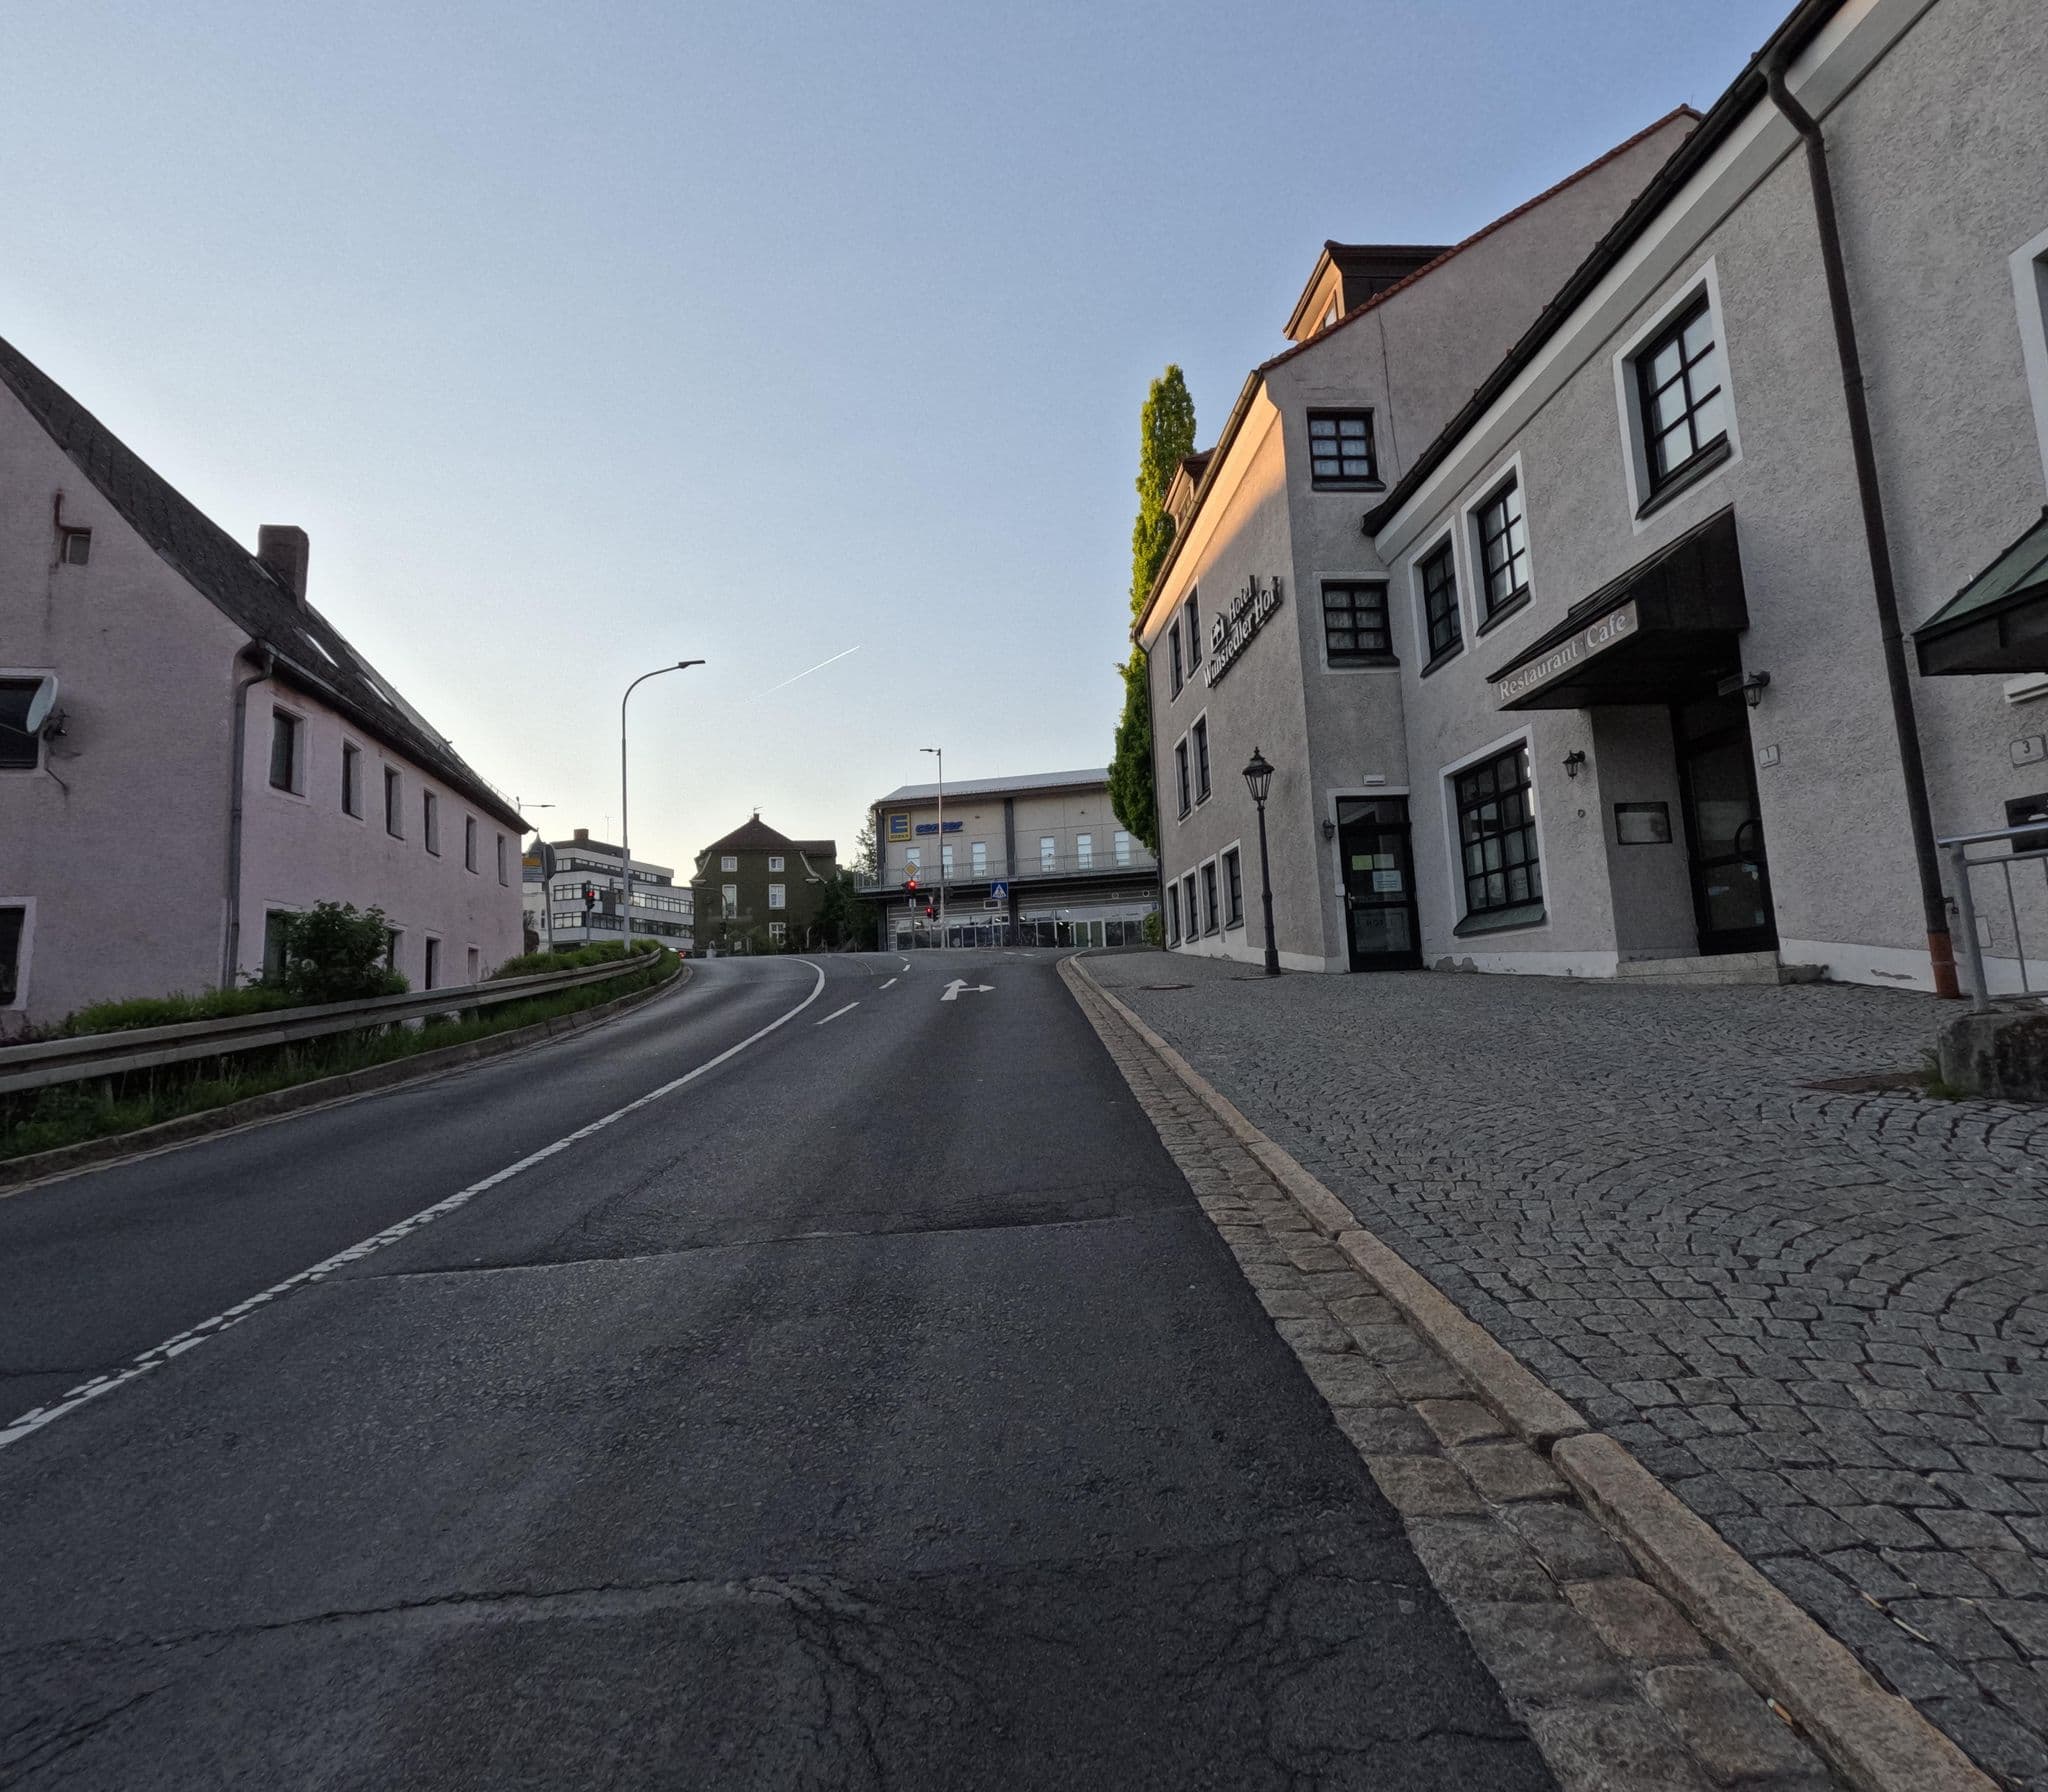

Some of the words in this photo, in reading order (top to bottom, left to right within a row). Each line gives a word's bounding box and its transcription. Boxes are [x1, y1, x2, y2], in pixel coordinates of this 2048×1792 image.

[1203, 612, 1253, 688] Wunsiedler
[1254, 576, 1284, 624] Hof
[1228, 574, 1257, 625] Hotel
[1499, 641, 1578, 700] Restaurant
[1586, 613, 1626, 649] Cafe
[2022, 740, 2031, 753] 3
